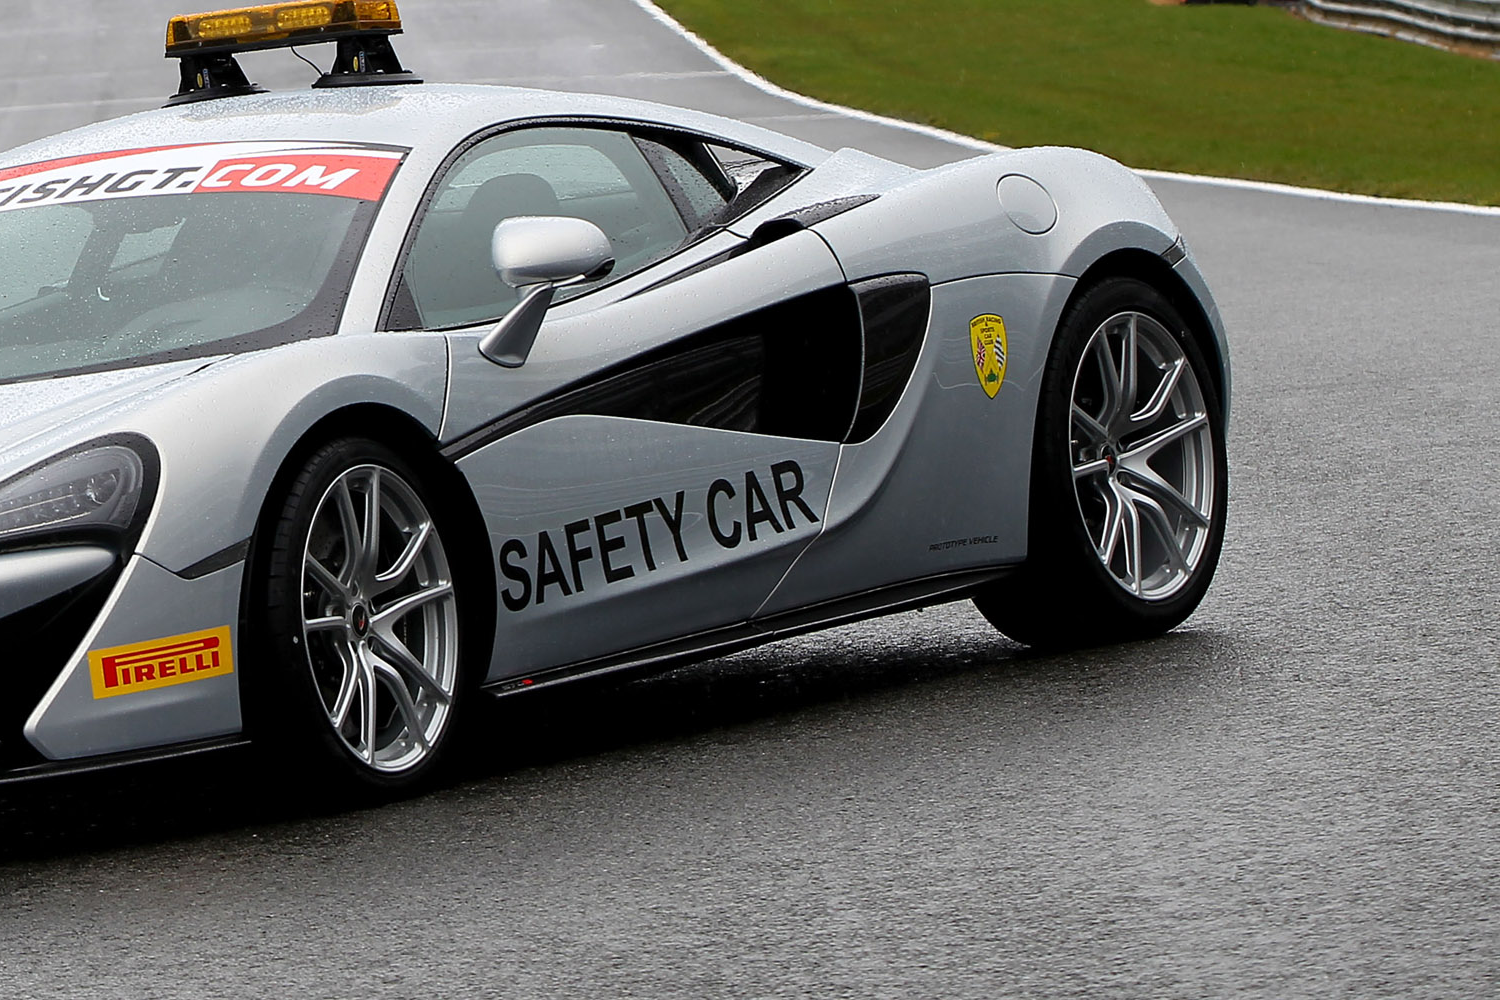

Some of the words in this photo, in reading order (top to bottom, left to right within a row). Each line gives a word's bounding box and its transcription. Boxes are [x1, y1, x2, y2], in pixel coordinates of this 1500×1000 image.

[500, 490, 689, 613] SAFETY
[707, 460, 820, 549] CAR
[928, 538, 968, 551] PROTOTYPE
[968, 535, 999, 545] VEHICLE
[101, 636, 220, 688] PIRELLI
